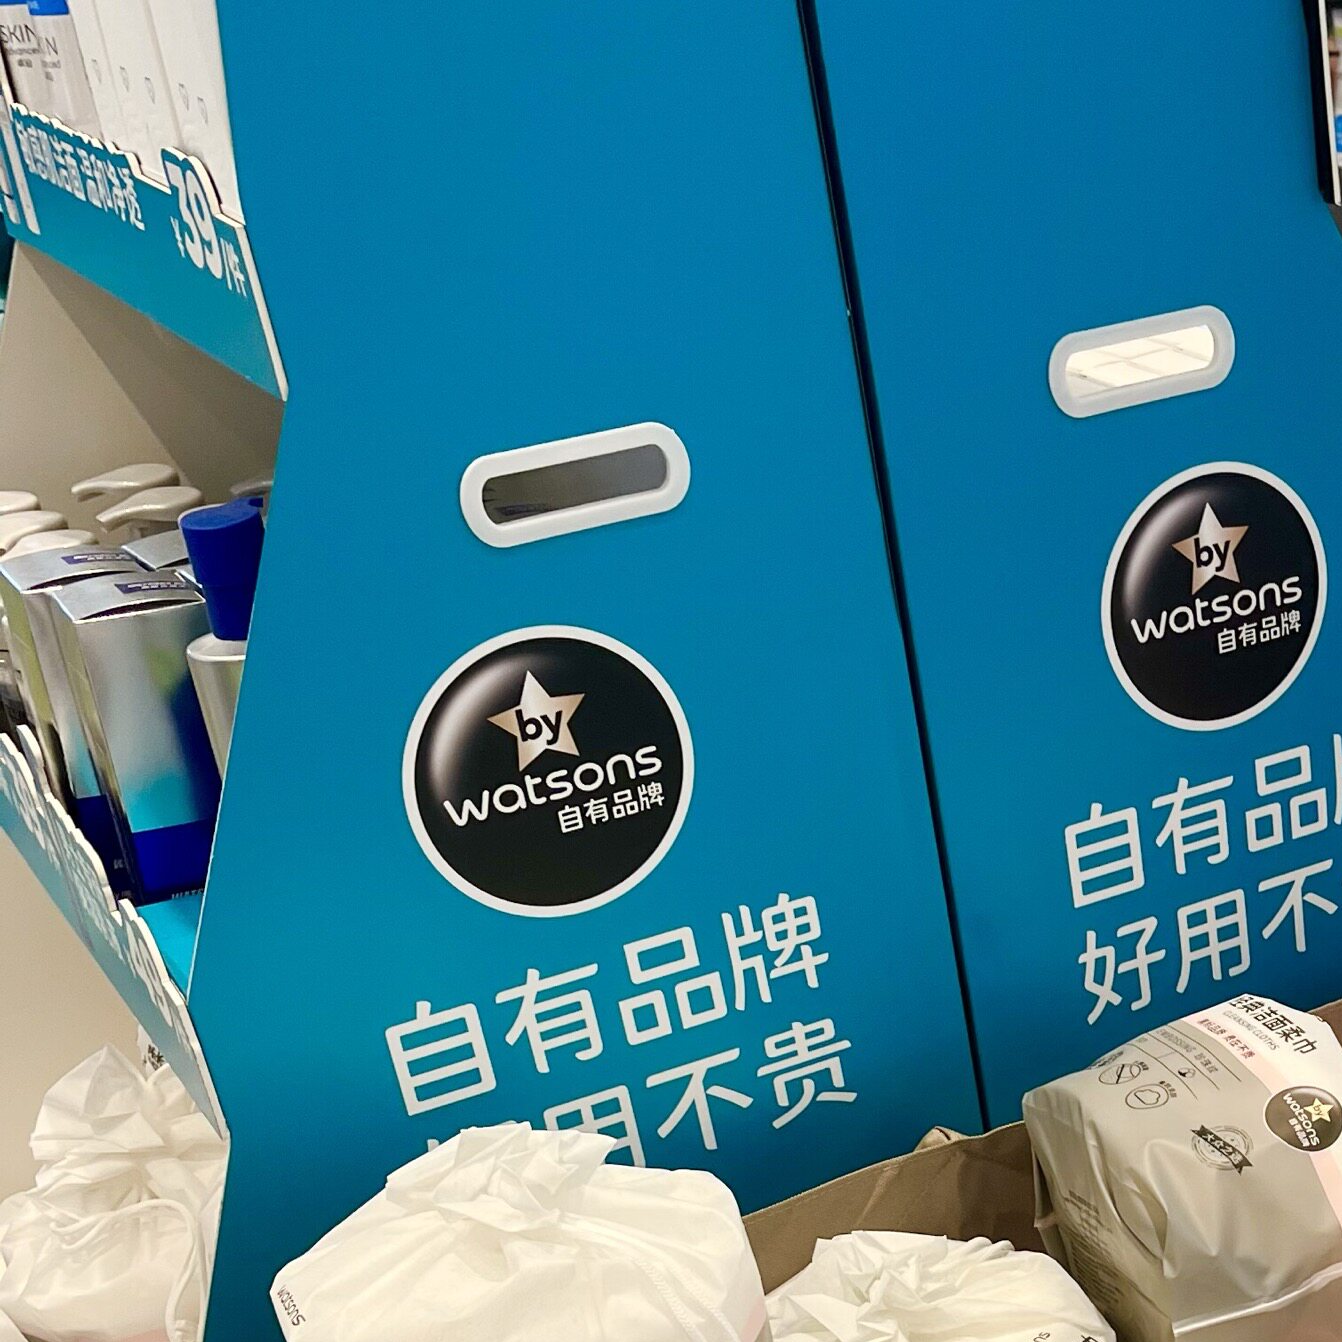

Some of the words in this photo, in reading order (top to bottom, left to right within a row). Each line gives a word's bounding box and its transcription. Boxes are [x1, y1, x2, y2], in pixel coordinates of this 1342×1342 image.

[1194, 536, 1231, 571] by
[1130, 576, 1303, 644] watsons
[1217, 610, 1302, 655] 自有品牌
[515, 707, 563, 745] by
[443, 745, 663, 827] watsons
[558, 782, 665, 834] 自有品牌
[385, 893, 829, 1117] 自有品牌
[428, 1018, 858, 1170] 用不贵
[1282, 1092, 1320, 1147] watsons
[277, 1285, 307, 1327] watsons
